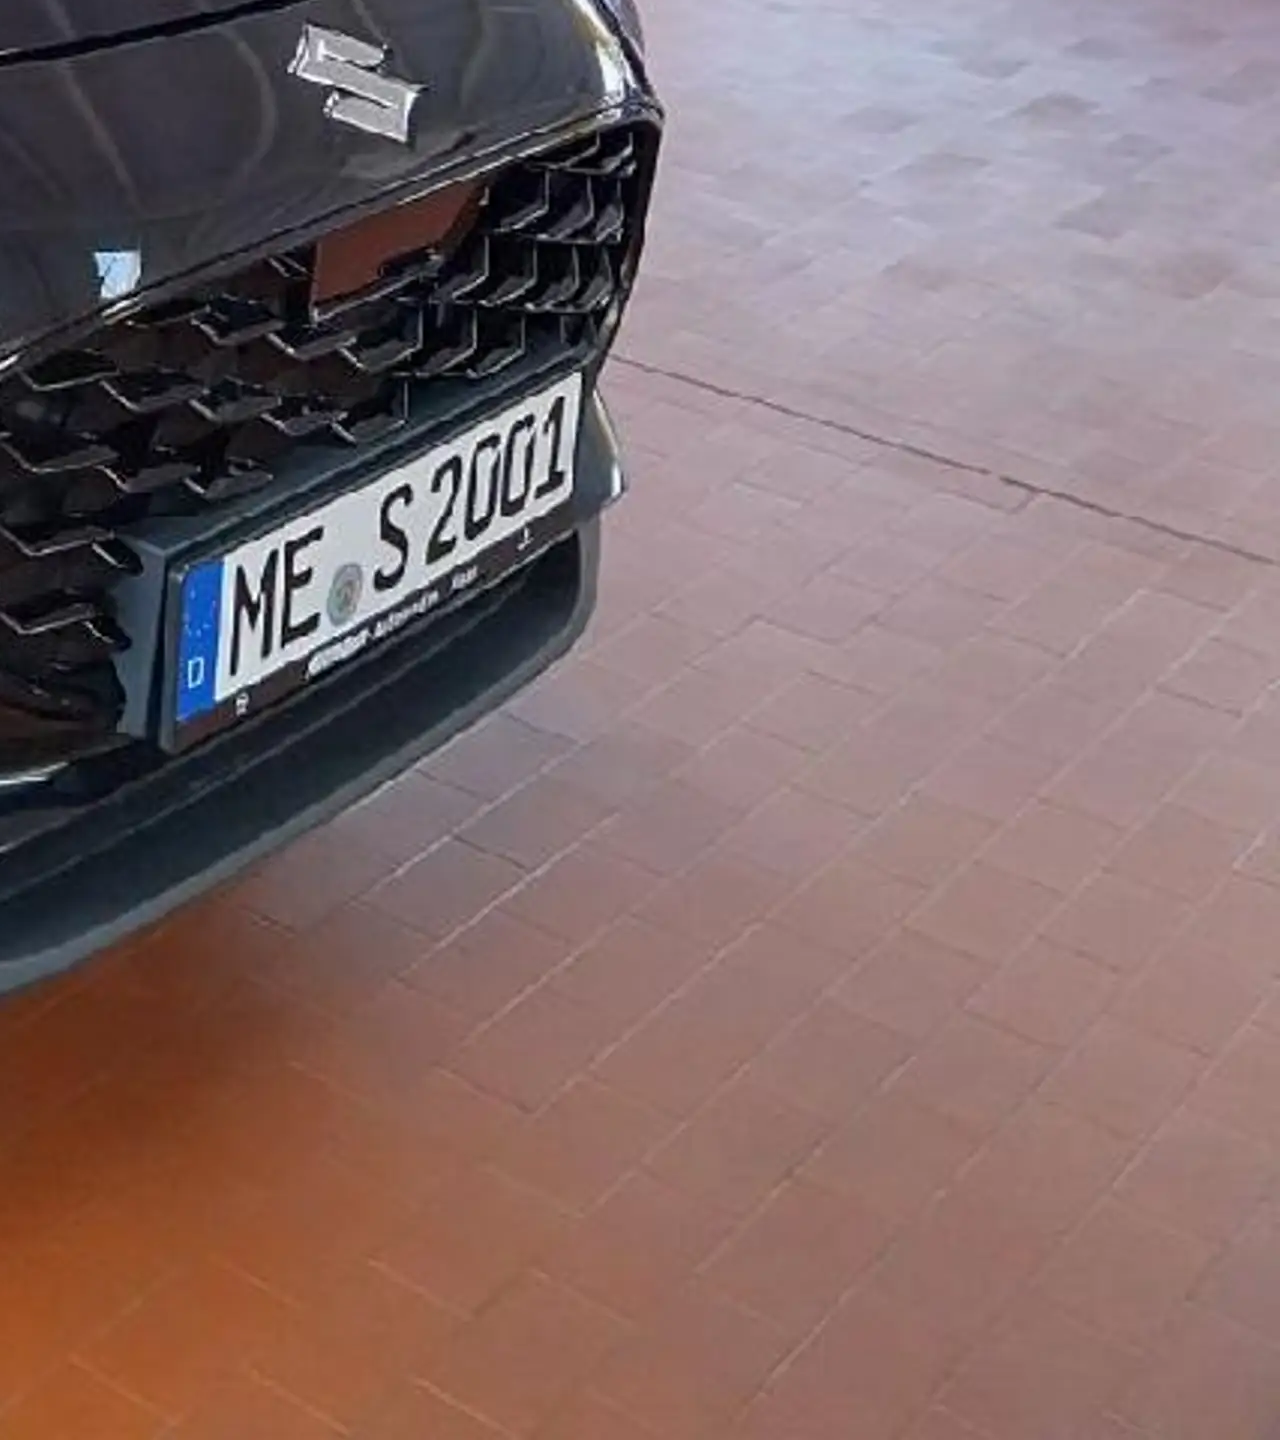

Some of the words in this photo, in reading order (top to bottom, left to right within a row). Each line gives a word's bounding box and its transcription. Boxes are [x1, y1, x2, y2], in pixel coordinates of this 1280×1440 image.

[187, 657, 205, 689] D
[230, 526, 324, 677] ME
[373, 484, 413, 592] S
[424, 395, 566, 566] 2001
